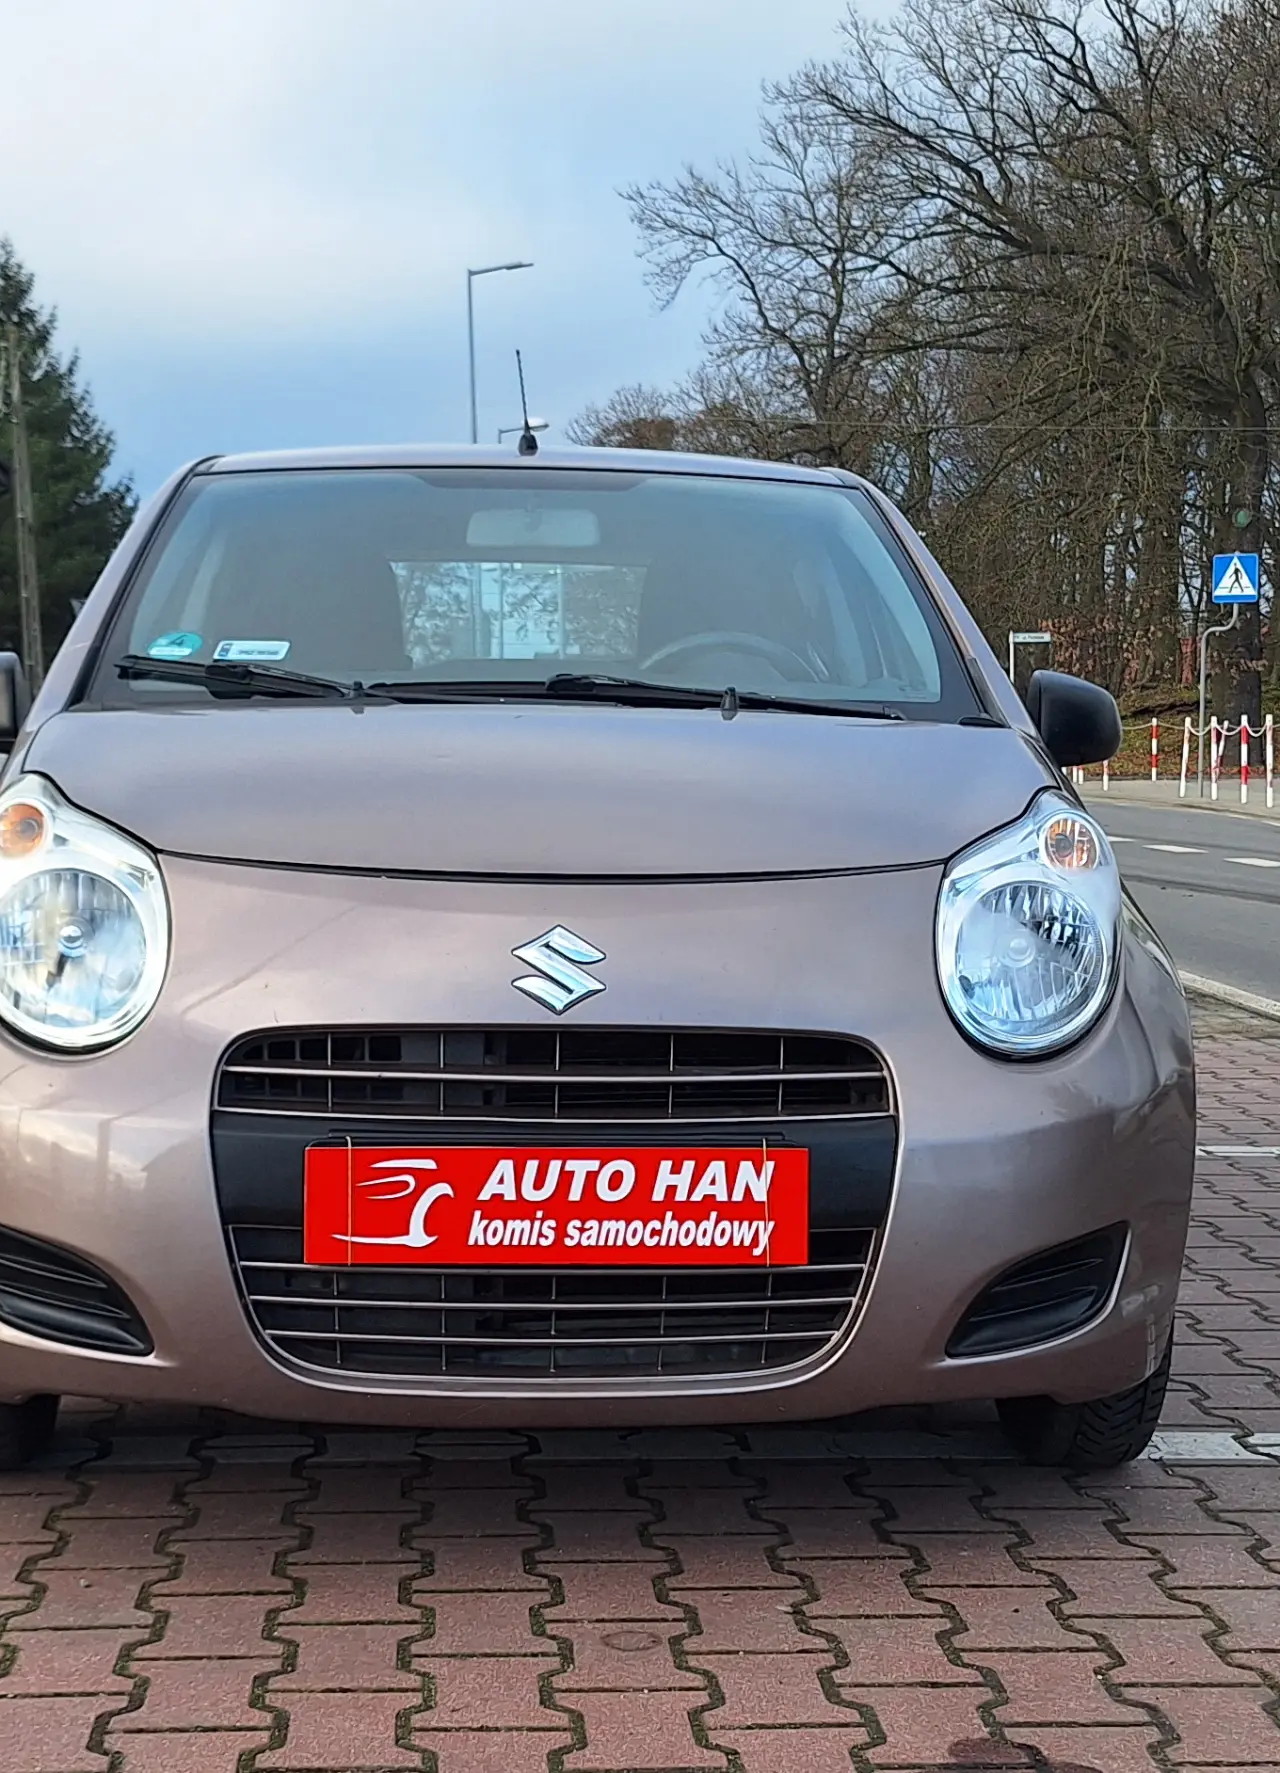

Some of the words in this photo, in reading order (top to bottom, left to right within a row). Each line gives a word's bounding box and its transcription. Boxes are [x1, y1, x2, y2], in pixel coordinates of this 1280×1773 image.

[477, 1159, 636, 1202] AUTO
[651, 1160, 775, 1202] HAN
[468, 1210, 557, 1246] komis
[563, 1211, 775, 1257] samochodowy
